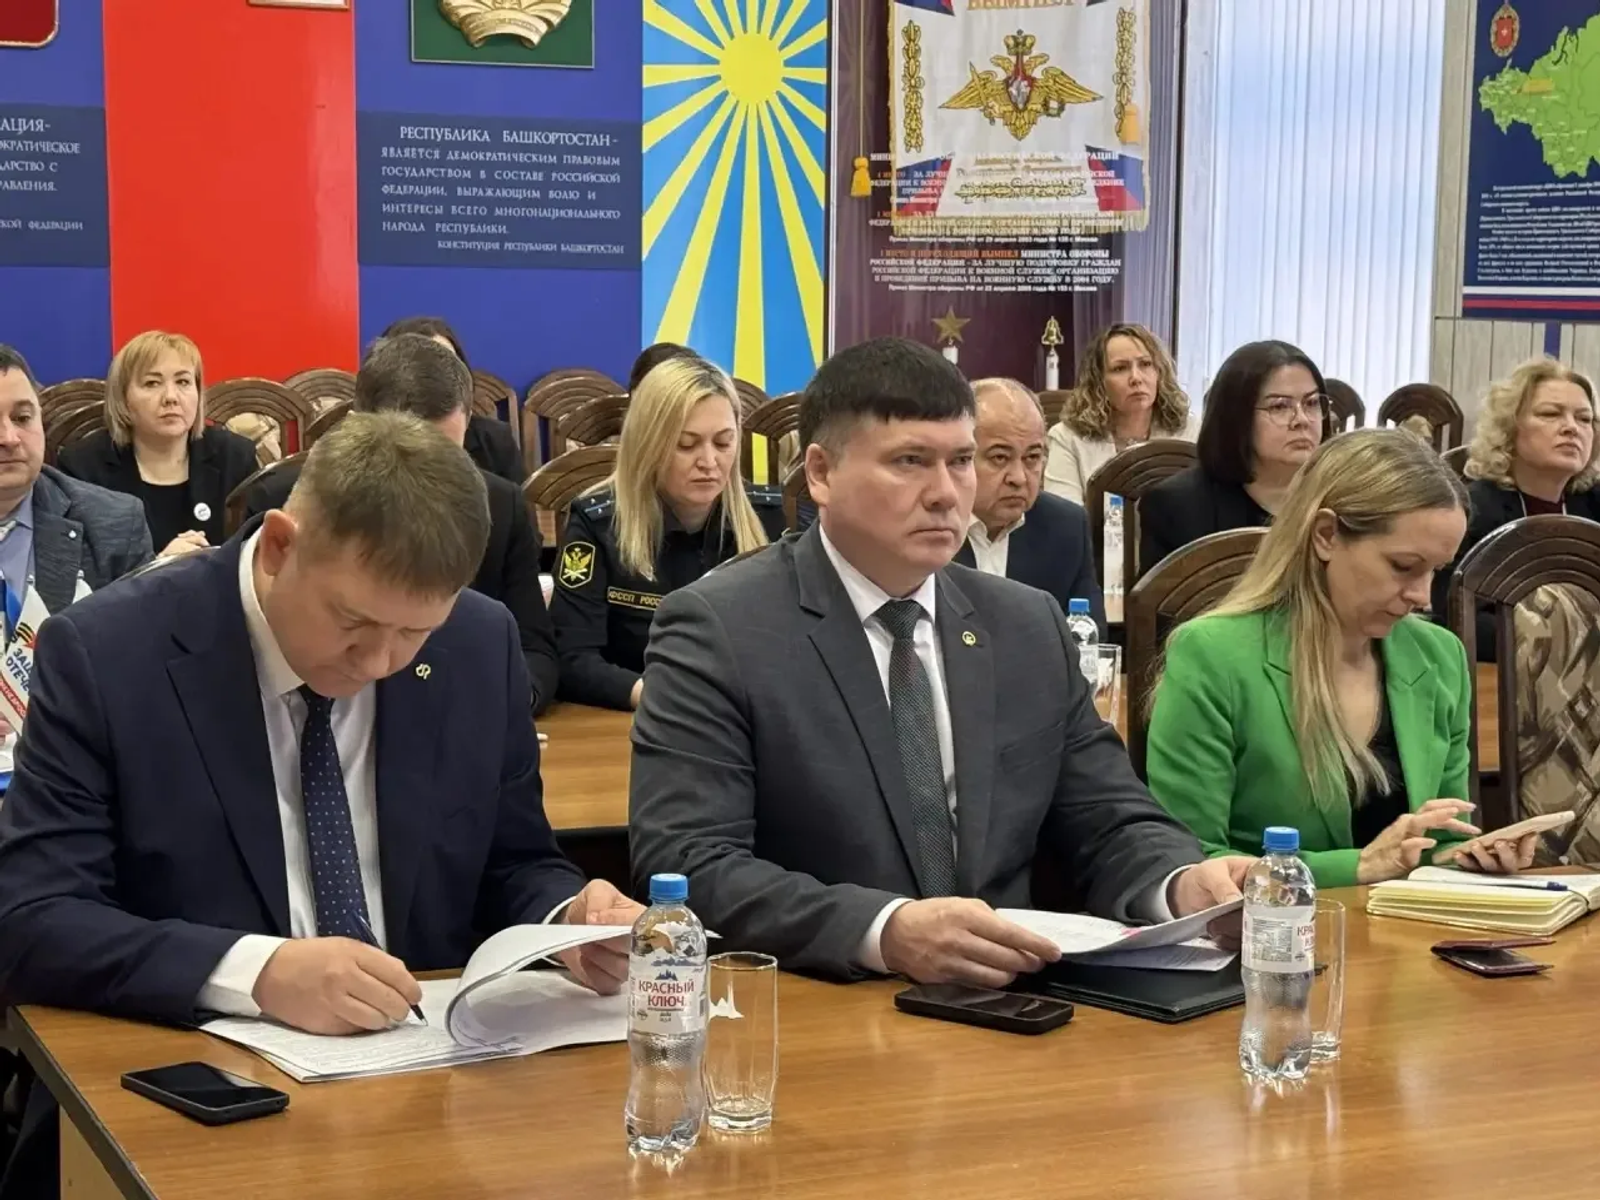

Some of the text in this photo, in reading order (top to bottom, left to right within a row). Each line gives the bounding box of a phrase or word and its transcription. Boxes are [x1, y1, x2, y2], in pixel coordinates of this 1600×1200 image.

[400, 126, 491, 142] РЕСПУБЛИКА
[381, 147, 621, 166] ЯВЛЯЕТСЯ ДЕМОКРАТИЧЕСКИМ ПРАВОВЫМ
[49, 161, 57, 172] С
[381, 166, 621, 184] ГОСУДАРСТВОМ В СОСТАВЕ РОССИЙСКОЙ
[456, 186, 541, 200] ВЫРАЖАЮЩИМ
[548, 189, 580, 200] ВОЛЮ
[587, 190, 596, 200] И
[382, 203, 621, 220] ИНТЕРЕСЫ ВСЕГО МНОГОНАЦИОНАЛЬНОГО
[28, 220, 83, 231] ФЕДЕРАЦИИ
[382, 221, 426, 232] НАРОДА
[437, 240, 624, 254] КОНСТИТУЦИЯ РЕСПУБЛИКИ БАШКОРТОСТАН
[609, 590, 635, 603] ФССП
[638, 979, 695, 994] КРАСНЫЙ
[647, 995, 685, 1008] КЛЮЧ
